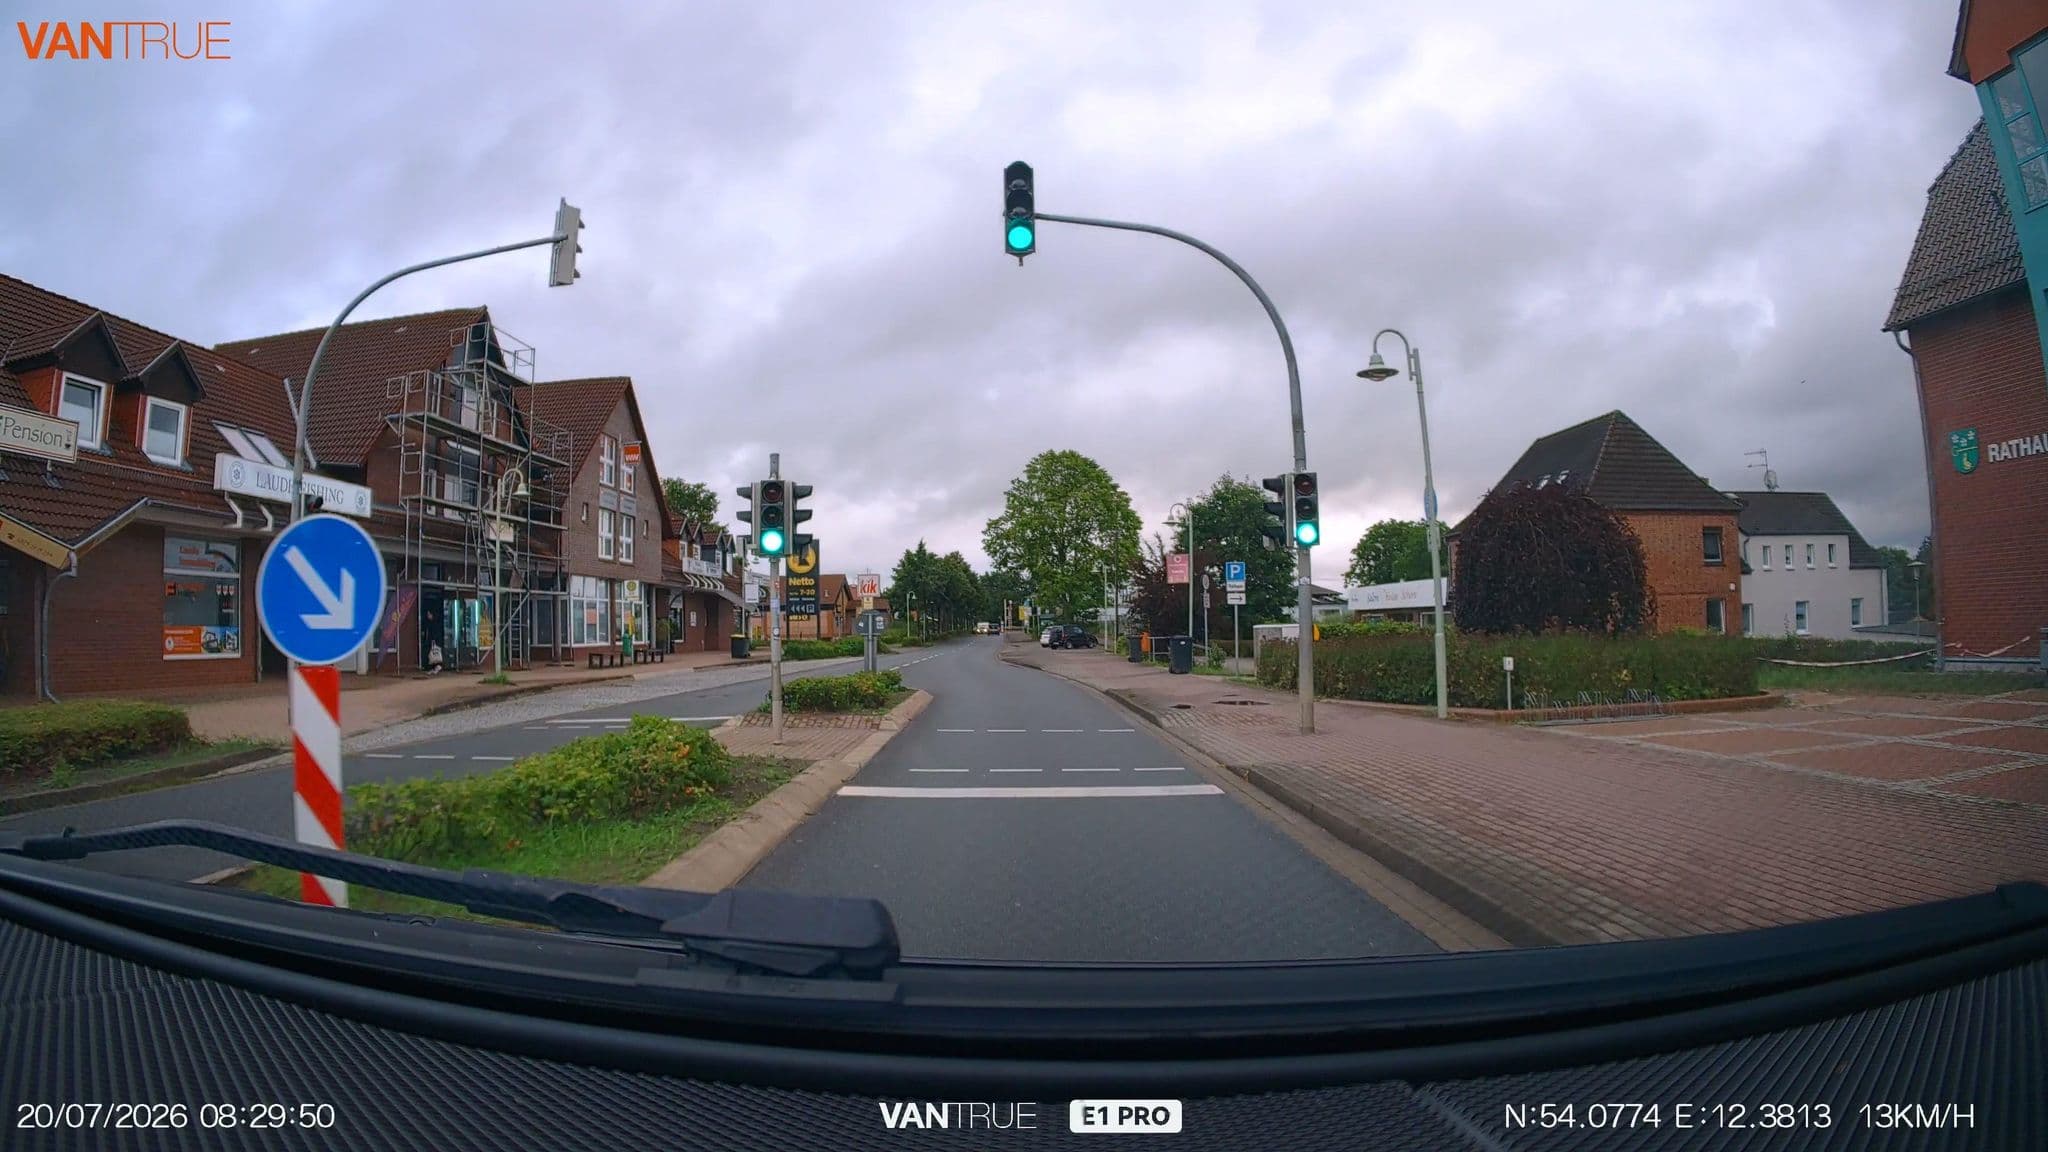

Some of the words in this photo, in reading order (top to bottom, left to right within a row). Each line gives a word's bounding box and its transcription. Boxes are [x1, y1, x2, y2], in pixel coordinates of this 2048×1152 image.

[3, 416, 62, 447] Pension
[1230, 564, 1241, 579] P
[788, 577, 815, 586] Netto
